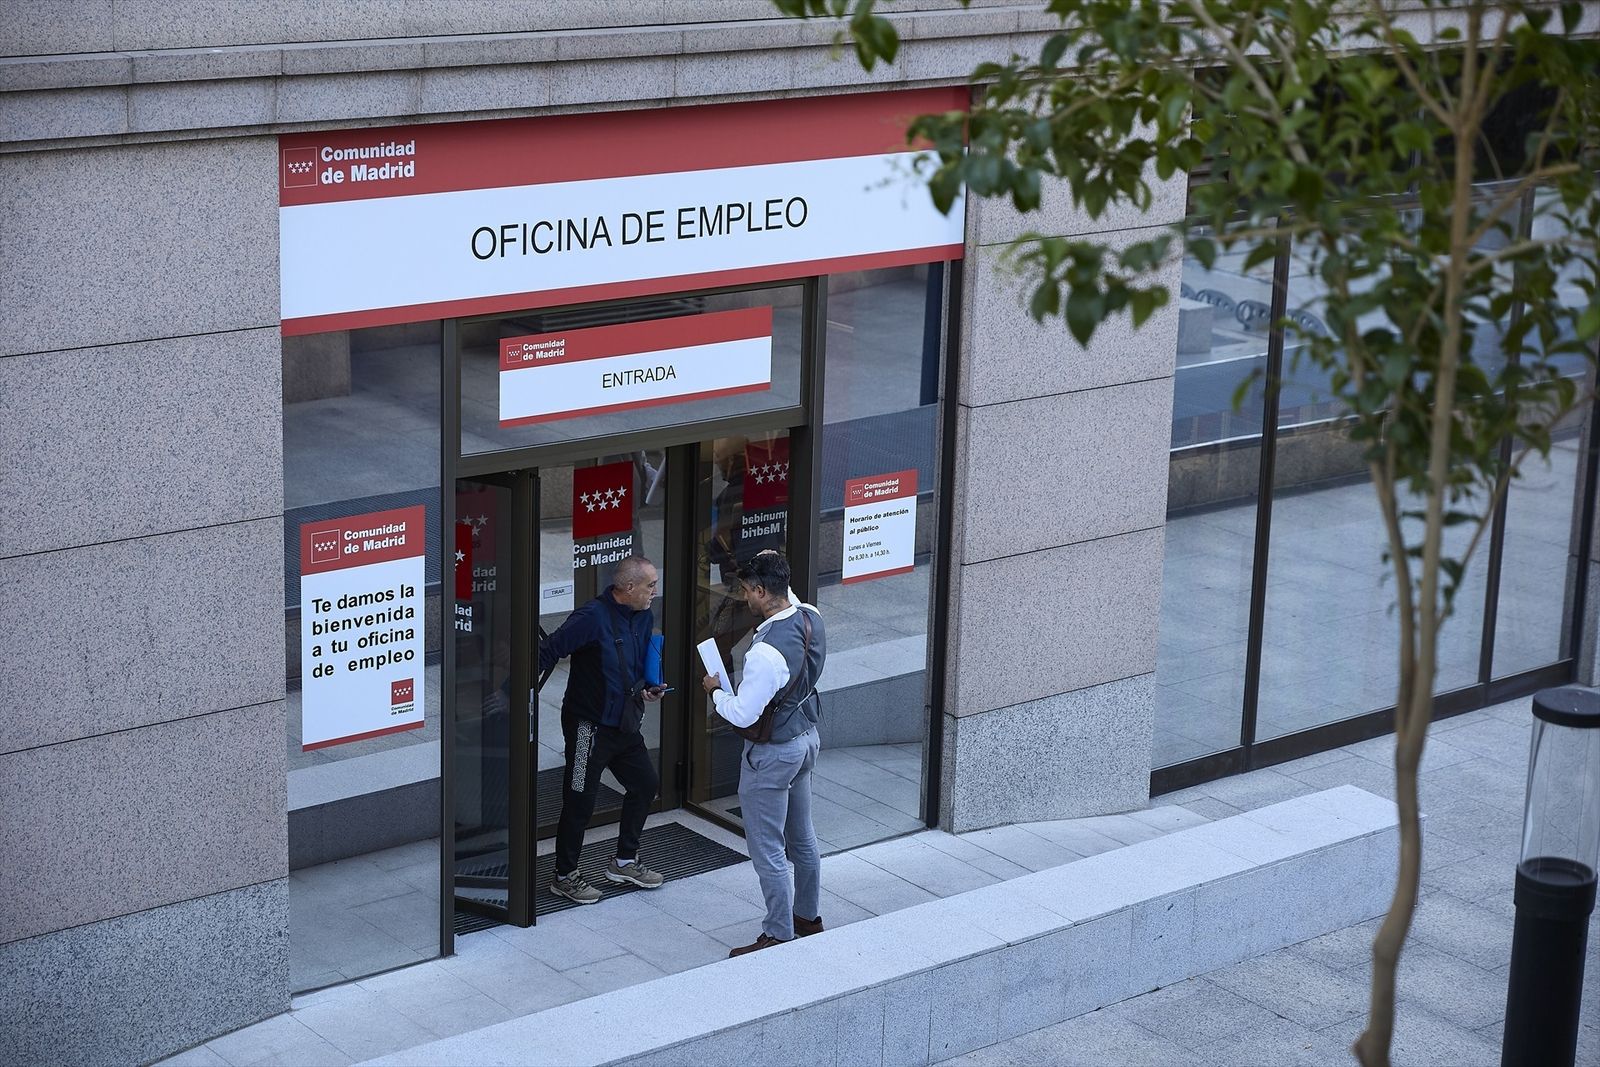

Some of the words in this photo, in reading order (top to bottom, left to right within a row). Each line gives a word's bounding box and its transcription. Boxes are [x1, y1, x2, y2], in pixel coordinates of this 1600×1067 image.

[321, 140, 415, 161] Comunidad
[321, 167, 344, 184] de
[351, 161, 415, 181] Madrid
[471, 216, 612, 260] OFICINA
[622, 210, 665, 245] DE
[677, 196, 808, 239] EMPLEO
[523, 339, 565, 350] Comunidad
[523, 352, 533, 360] de
[536, 348, 565, 359] Madrid
[602, 365, 676, 388] ENTRADA
[864, 479, 899, 490] Comunidad
[875, 486, 899, 496] Madrid
[850, 515, 873, 523] Horario
[883, 509, 909, 518] atención
[344, 522, 406, 540] Comunidad
[857, 525, 879, 534] público
[344, 544, 359, 554] de
[363, 535, 406, 551] Madrid
[572, 535, 633, 554] Comunidad
[572, 558, 586, 569] de
[312, 598, 331, 613] Te
[337, 589, 394, 609] damos
[401, 584, 414, 598] la
[313, 605, 414, 635] bienvenida
[312, 645, 322, 657] a
[331, 640, 348, 653] tu
[358, 628, 414, 648] oficina
[313, 663, 334, 678] de
[348, 649, 414, 671] empleo
[391, 703, 414, 711] Comunidad
